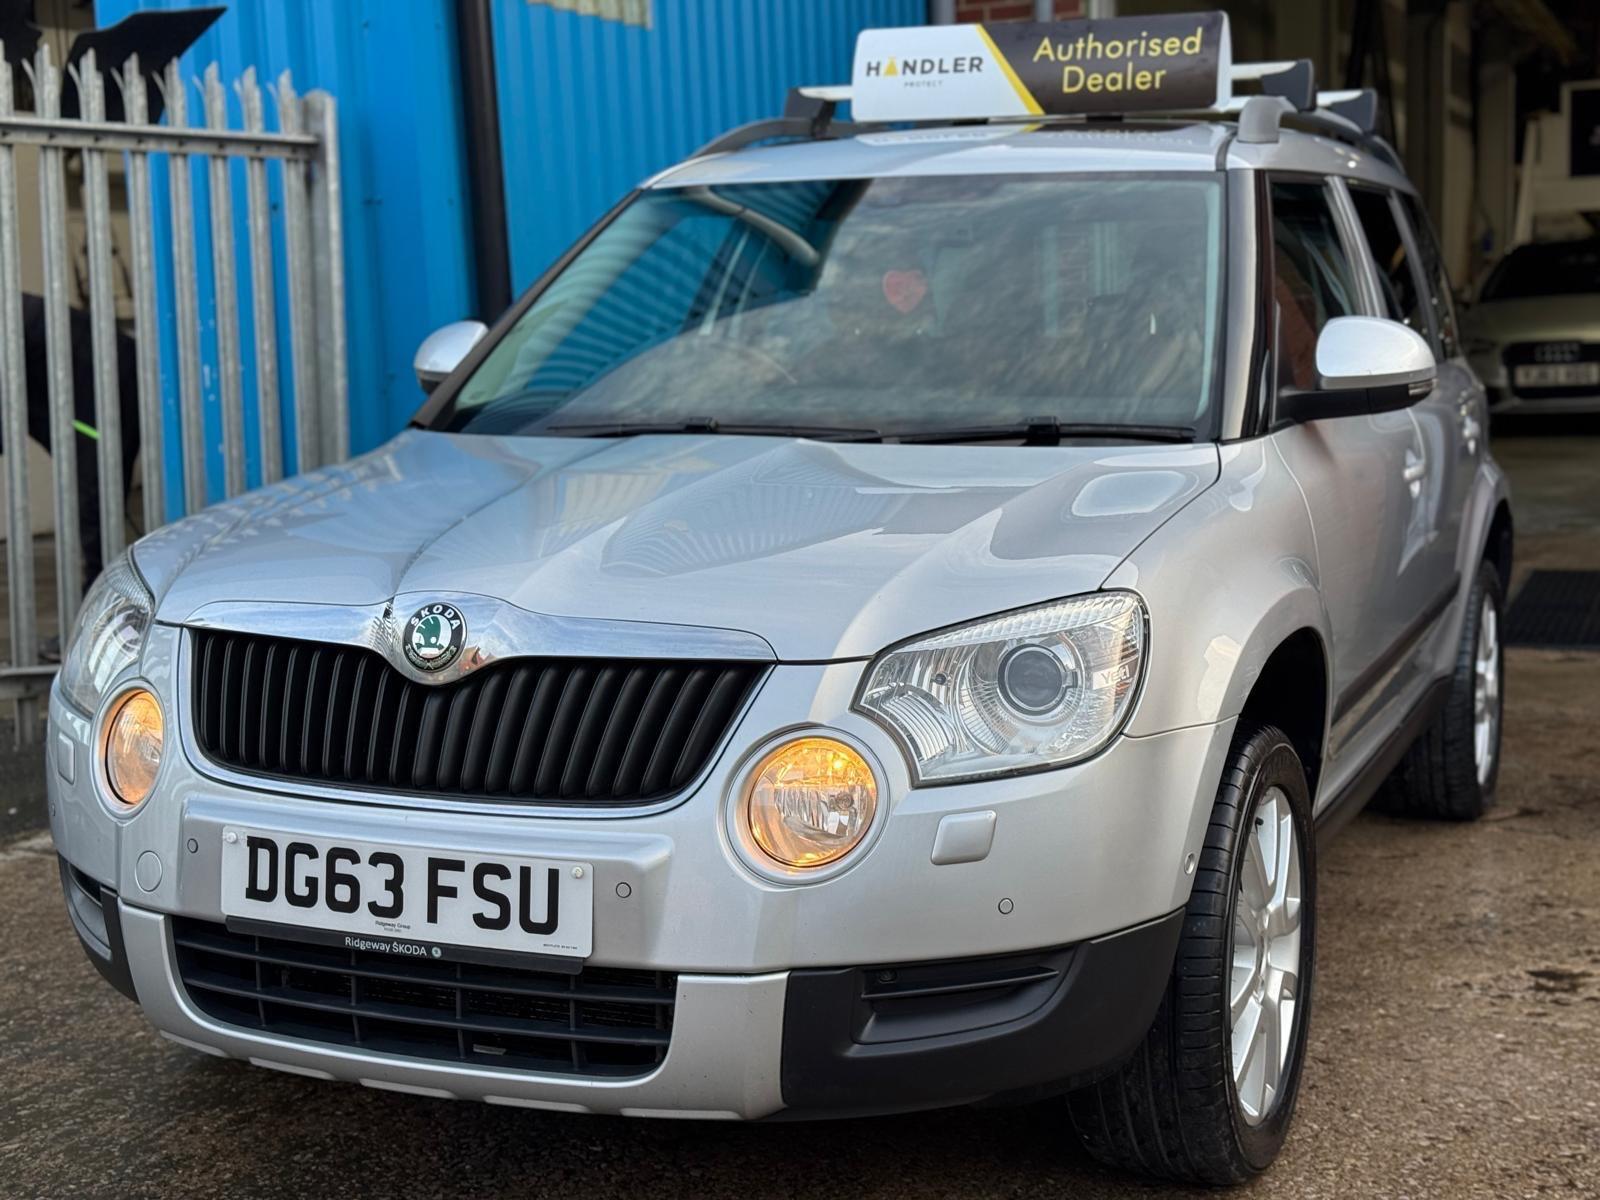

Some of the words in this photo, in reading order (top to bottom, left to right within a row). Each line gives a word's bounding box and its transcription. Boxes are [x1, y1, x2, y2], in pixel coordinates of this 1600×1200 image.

[1032, 26, 1203, 62] Authorised
[1062, 61, 1167, 93] Dealer
[245, 836, 405, 919] DG63
[427, 857, 560, 936] FSU
[345, 937, 391, 953] Ridgeway
[392, 941, 427, 956] ŠKODA
